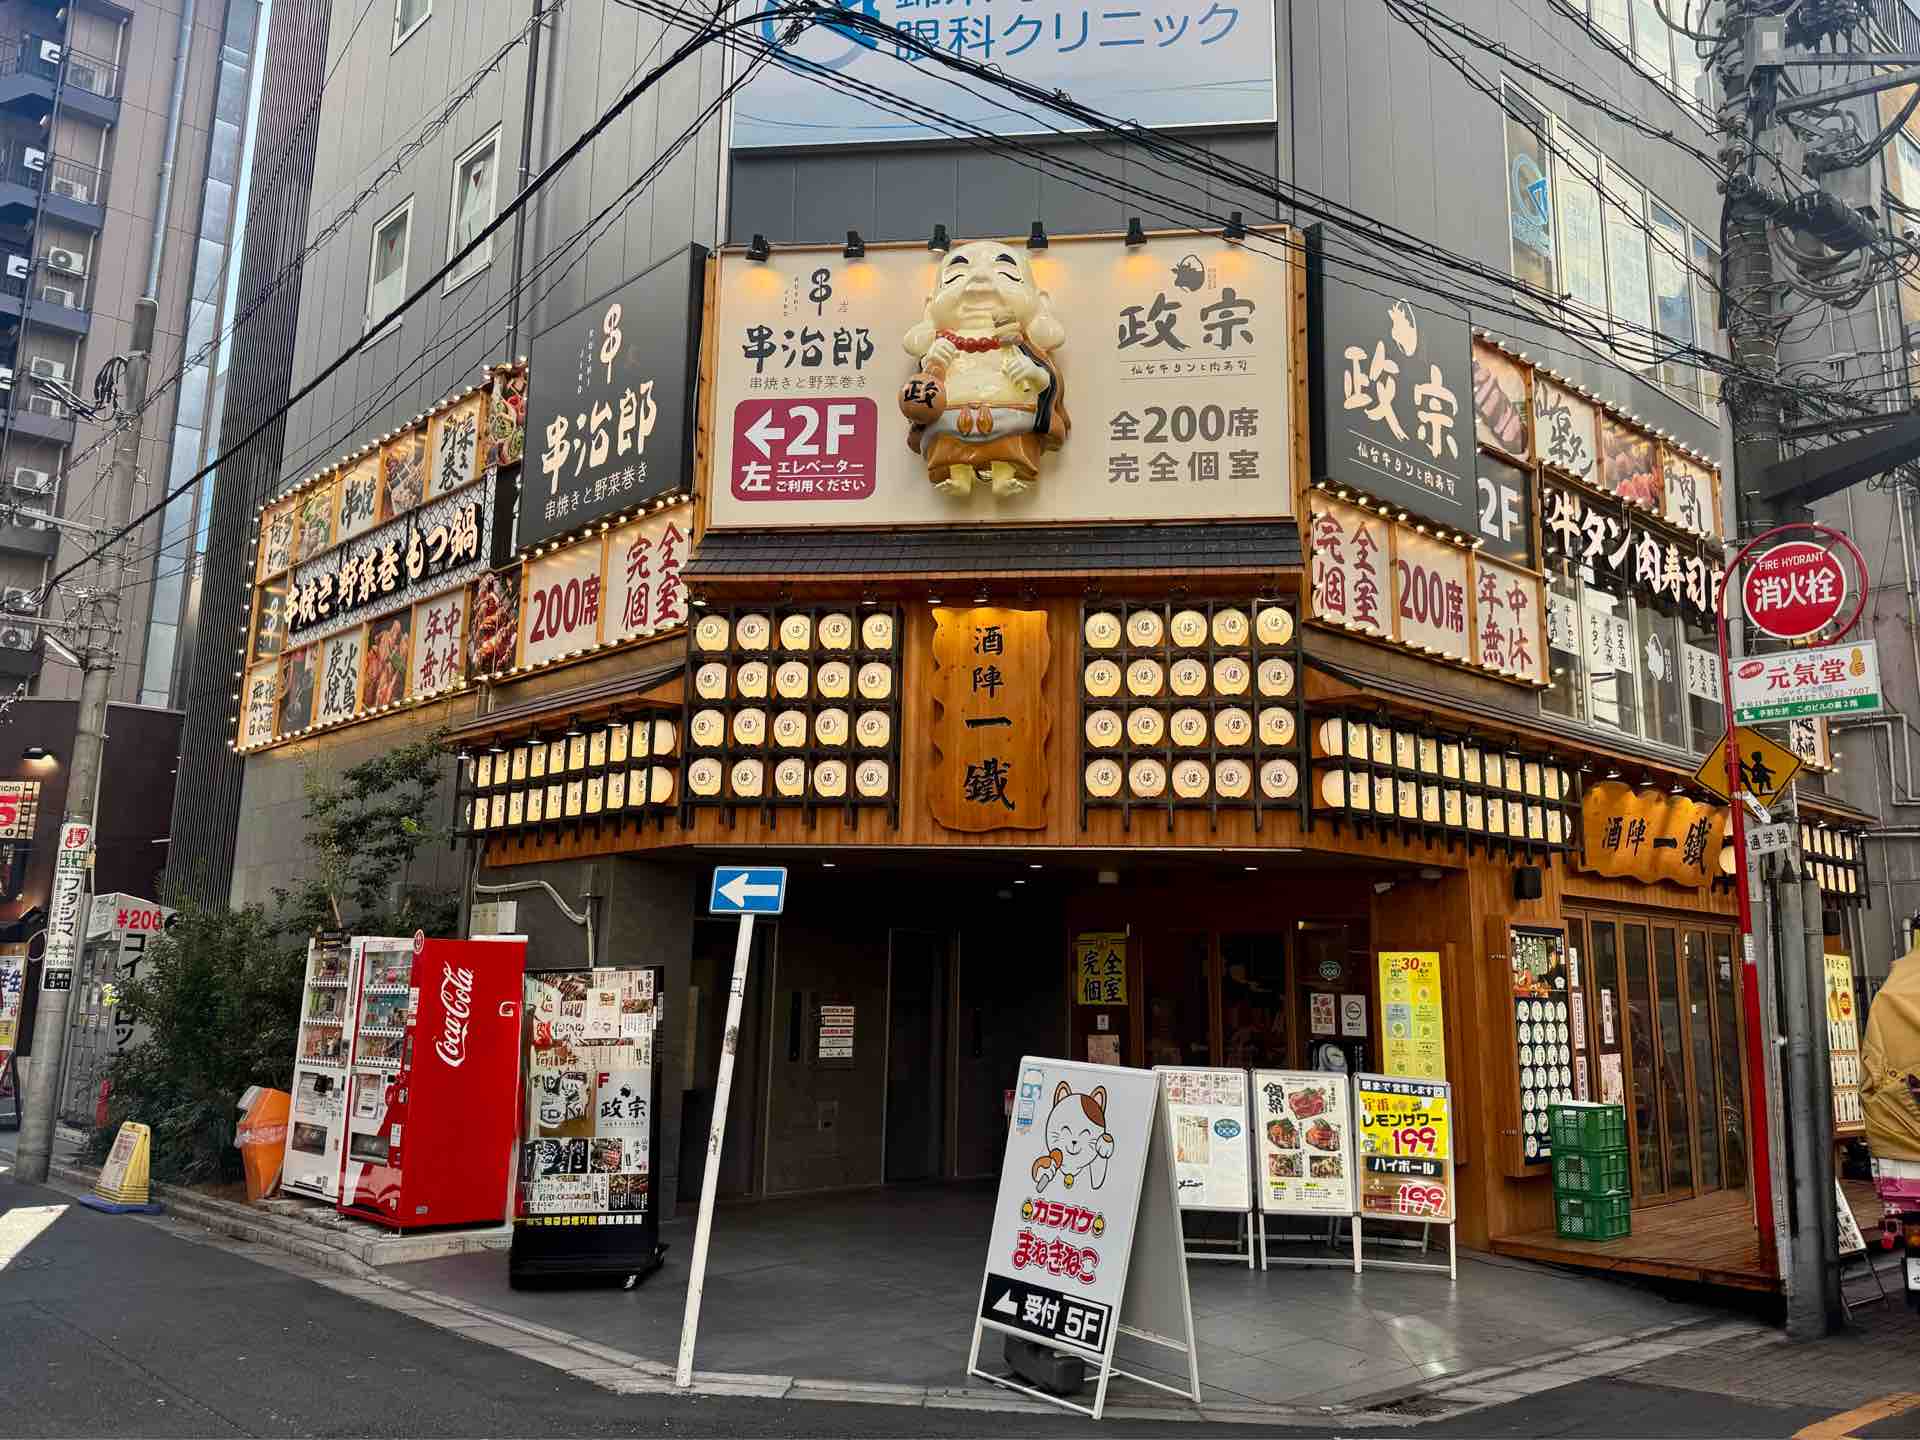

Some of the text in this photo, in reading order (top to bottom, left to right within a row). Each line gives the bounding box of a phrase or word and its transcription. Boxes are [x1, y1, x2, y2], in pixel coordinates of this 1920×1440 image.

[896, 3, 1241, 62] 眼科クリニック
[1117, 288, 1256, 352] 政宗
[742, 325, 875, 373] 串治郎
[750, 376, 866, 391] 串焼きと野菜巻き
[1343, 339, 1459, 459] 政宗
[541, 380, 657, 495] 串治郎
[786, 404, 857, 456] 2F
[1109, 404, 1259, 443] 全200席
[740, 461, 772, 491] 左
[776, 480, 866, 492] ご利用ください
[777, 459, 864, 474] エレベーター
[1109, 449, 1260, 483] 完全個室
[1357, 441, 1455, 497] 仙台牛タンと肉寿司
[544, 462, 649, 521] 串焼きと野菜巻き
[1477, 477, 1520, 543] 2F
[406, 502, 478, 580] もつ鍋
[627, 521, 684, 584] 完全
[1315, 511, 1378, 576] 完全
[1548, 491, 1632, 570] 牛タン
[1635, 530, 1707, 613] 肉寿司
[1759, 552, 1824, 571] FIRE HYDRANT
[530, 573, 600, 643] 200席
[623, 571, 683, 632] 個室
[1318, 560, 1380, 629] 個室
[1398, 559, 1464, 634] 200席
[1479, 565, 1529, 626] 年中
[1753, 566, 1837, 613] 消火栓
[425, 603, 463, 642] 年中
[1481, 614, 1534, 673] 無休
[1767, 658, 1847, 690] 元気堂
[1750, 828, 1788, 851] 通学路
[1083, 951, 1123, 975] 完全
[435, 961, 473, 1067] Coca-Cola
[1083, 979, 1123, 1003] 個室
[601, 1096, 646, 1119] 政宗
[1362, 1113, 1442, 1127] レモンサワー
[1392, 1126, 1436, 1154] 199
[1374, 1158, 1434, 1175] ハイボール
[1034, 1200, 1094, 1233] カラオケ
[1399, 1183, 1446, 1216] 199
[1011, 1228, 1101, 1284] まねきねこ
[1022, 1293, 1099, 1341] 受付 5F
